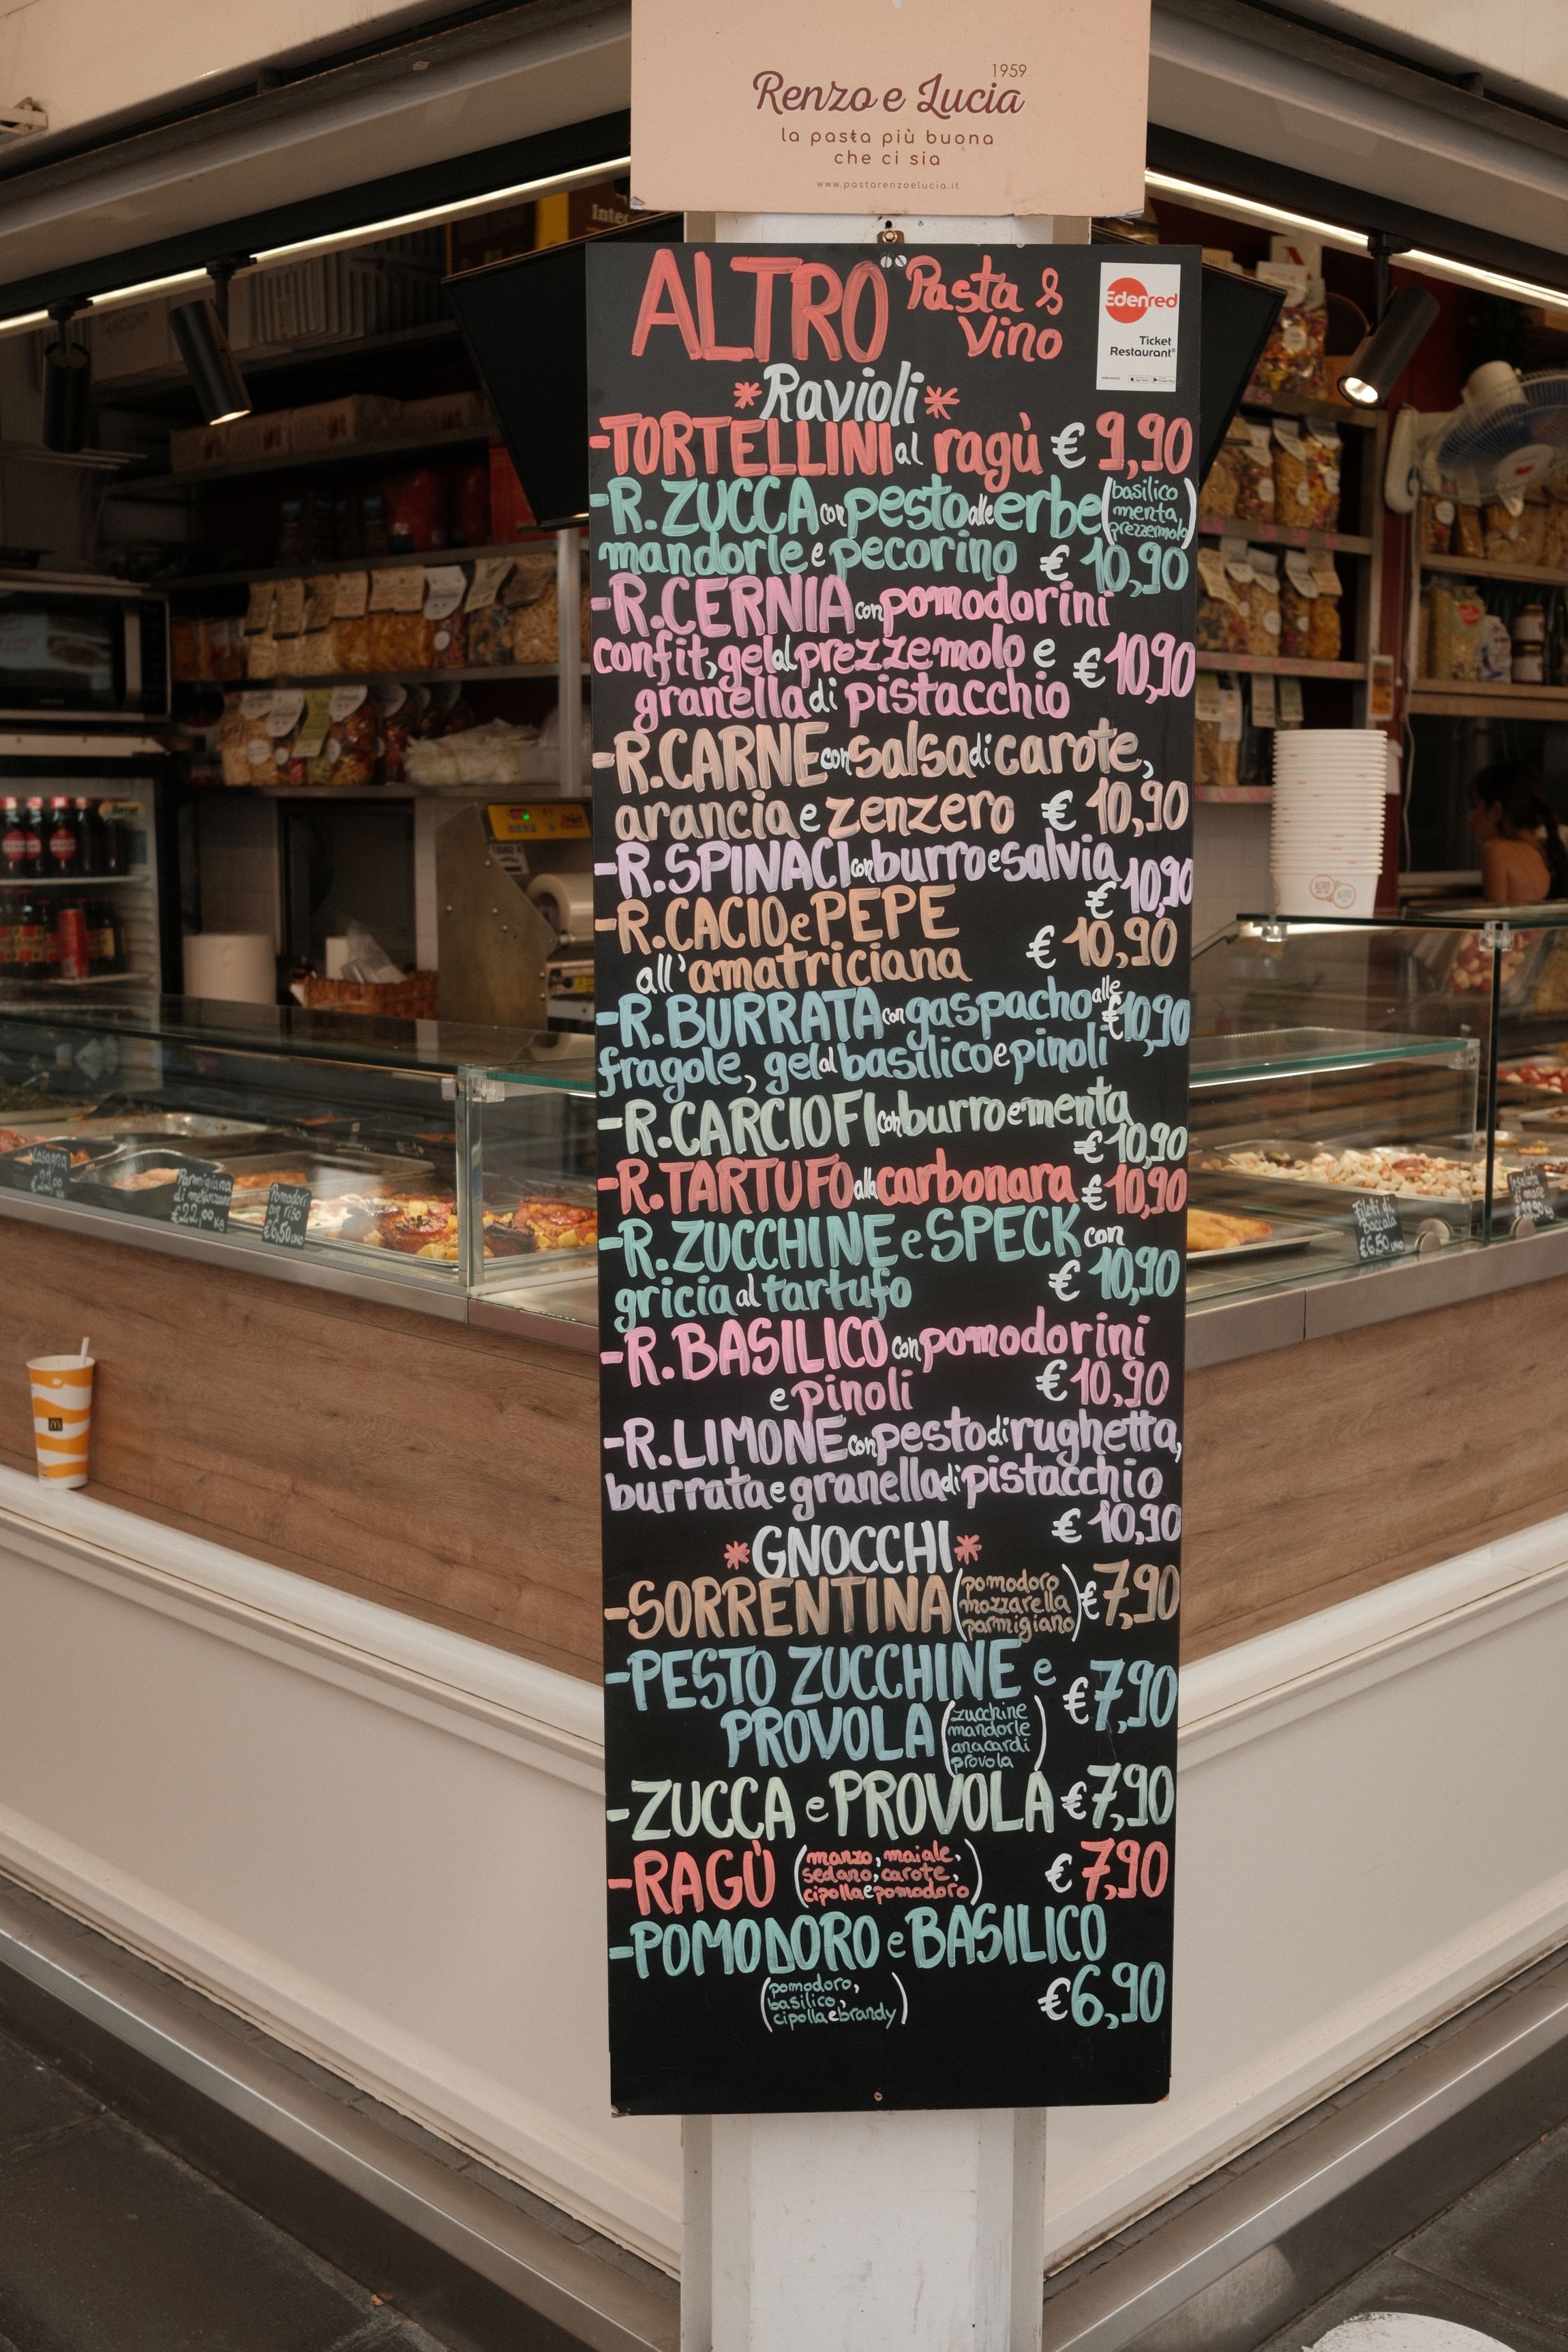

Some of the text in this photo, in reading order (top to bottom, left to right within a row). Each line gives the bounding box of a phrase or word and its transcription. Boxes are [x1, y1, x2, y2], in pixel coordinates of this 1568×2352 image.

[752, 70, 1026, 121] Renzo e Lucia
[991, 63, 1028, 78] 1959
[781, 127, 994, 148] la pasta più buona
[834, 149, 941, 167] che ci sia
[816, 179, 961, 192] www.pastarenzoelucia.it
[631, 248, 890, 363] ALTRO
[906, 255, 1024, 314] Pasta
[1105, 290, 1178, 309] Edenred
[958, 315, 1064, 361] Vino
[1139, 335, 1171, 346] Ticket
[759, 360, 925, 426] Ravioli
[933, 411, 1044, 493] ragù
[1096, 410, 1193, 479] 9,90
[820, 503, 847, 527] con
[844, 474, 969, 539] pesto
[968, 493, 995, 527] alle
[994, 474, 1102, 539] erbe
[1113, 502, 1178, 524] menta
[598, 529, 1190, 597] mandorle pecorino 10,90
[854, 601, 884, 622] con
[879, 575, 1115, 638] pomodorini
[718, 634, 777, 693] gel
[794, 623, 1025, 689] prezzemolo
[633, 667, 1070, 734] granella pistacchio
[819, 747, 852, 776] con
[847, 719, 976, 779] salsa
[615, 777, 1190, 842] arancia zenzero 10,90
[850, 858, 876, 884] con
[871, 838, 986, 883] burro
[1001, 828, 1123, 882] salvia
[810, 883, 960, 947] PEPE
[1061, 916, 1178, 969] 10,90
[881, 1006, 905, 1026] con
[905, 975, 1093, 1051] gaspacho
[763, 1042, 823, 1096] gel
[836, 1033, 994, 1081] basilico
[1009, 1021, 1109, 1085] pinoli
[877, 1110, 903, 1138] con
[898, 1089, 1006, 1137] burro
[1021, 1075, 1134, 1129] menta
[174, 1186, 186, 1202] di
[177, 1168, 232, 1193] Parmigiana
[271, 1183, 309, 1207] Pomodori
[853, 1166, 879, 1201] alla
[876, 1147, 1079, 1207] carbonara
[284, 1205, 301, 1222] riso
[925, 1204, 1083, 1263] SPECK
[1083, 1224, 1126, 1248] con
[614, 1246, 1181, 1334] gricia tartufo 10,90
[891, 1335, 922, 1362] con
[918, 1305, 1151, 1374] pomodorini
[790, 1365, 914, 1422] pinoli
[847, 1434, 878, 1458] con
[871, 1406, 989, 1466] pesto
[604, 1452, 1164, 1522] burrata granella pistacchio
[751, 1520, 954, 1579] GNOCCHI
[1087, 1500, 1182, 1545] 10,90
[788, 1638, 1023, 1705] ZUCCHINE
[721, 1702, 935, 1768] PROVOLA
[948, 1719, 1031, 1738] mandorle
[950, 1702, 1028, 1722] zucchine
[950, 1752, 1014, 1775] provola
[805, 1796, 830, 1822] e
[828, 1769, 1055, 1841] PROVOLA
[863, 1884, 874, 1899] e
[1081, 1837, 1169, 1902] 7,90
[887, 1931, 906, 1958] e
[905, 1903, 1107, 1969] BASILICO
[774, 2002, 896, 2031] cipolla e brandy
